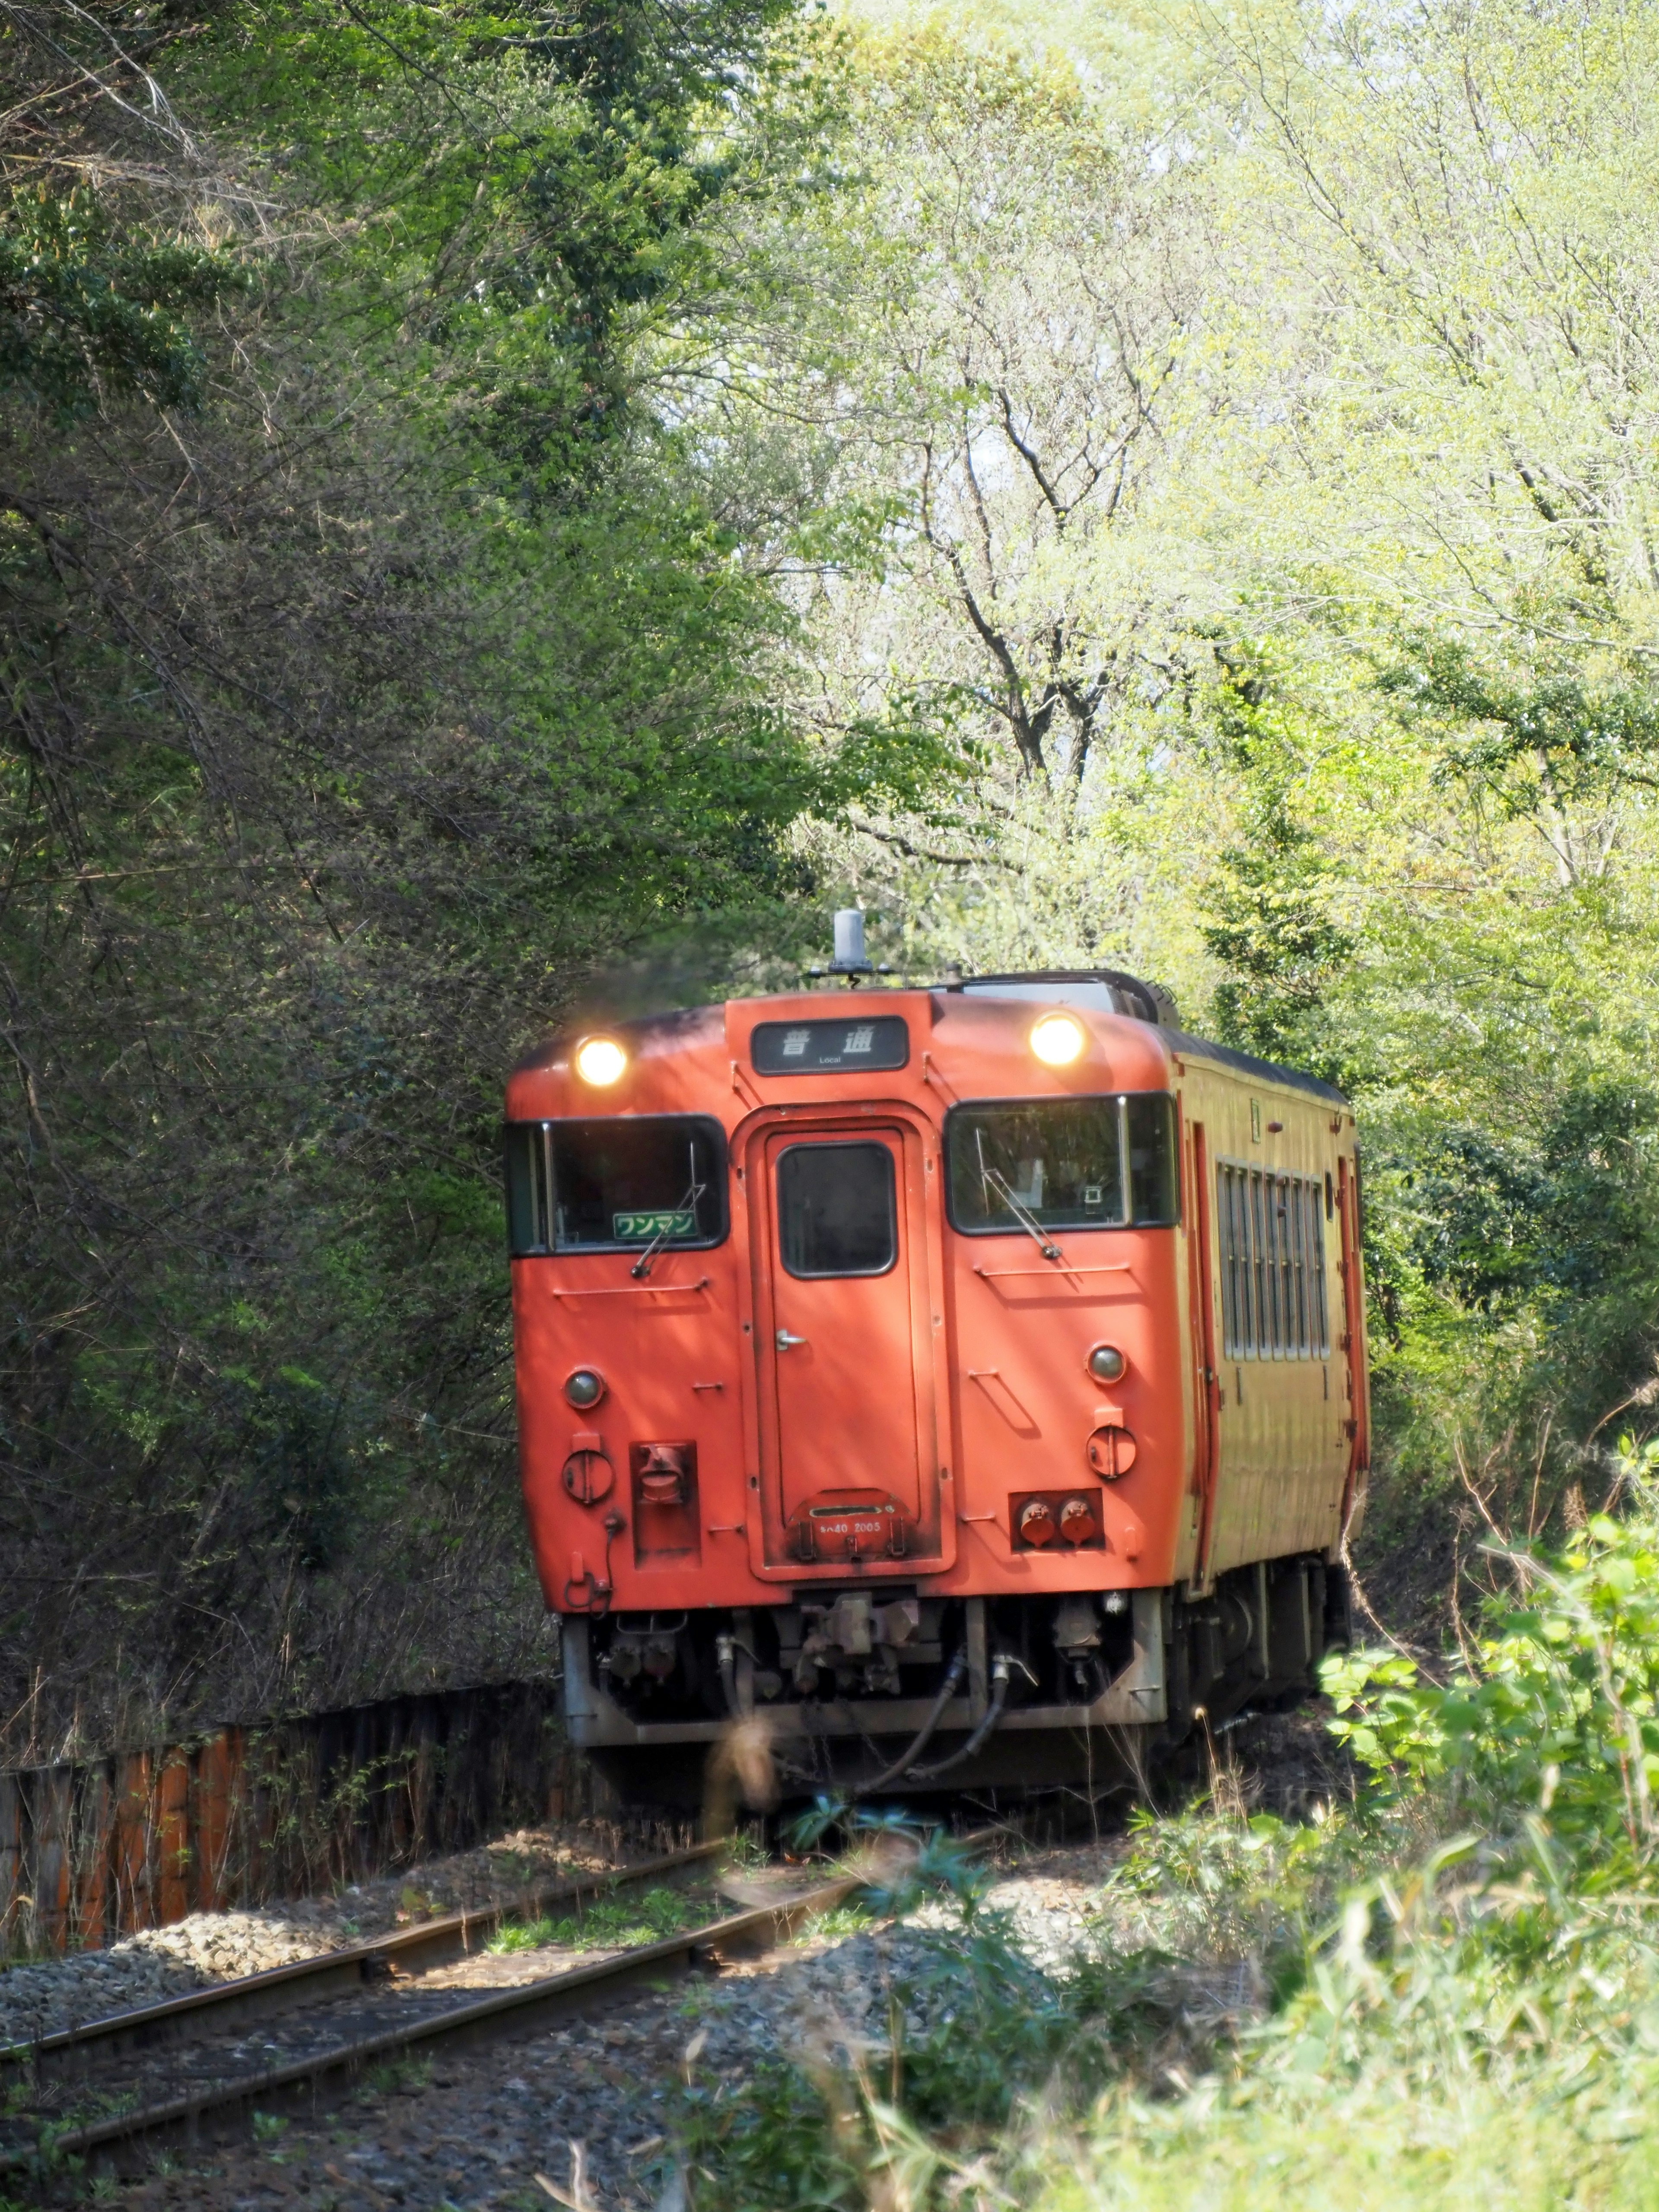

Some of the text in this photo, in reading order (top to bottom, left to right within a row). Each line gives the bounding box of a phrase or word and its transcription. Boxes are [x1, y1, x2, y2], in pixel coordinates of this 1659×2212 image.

[618, 1215, 692, 1235] ワンマン
[855, 1522, 880, 1532] 2005
